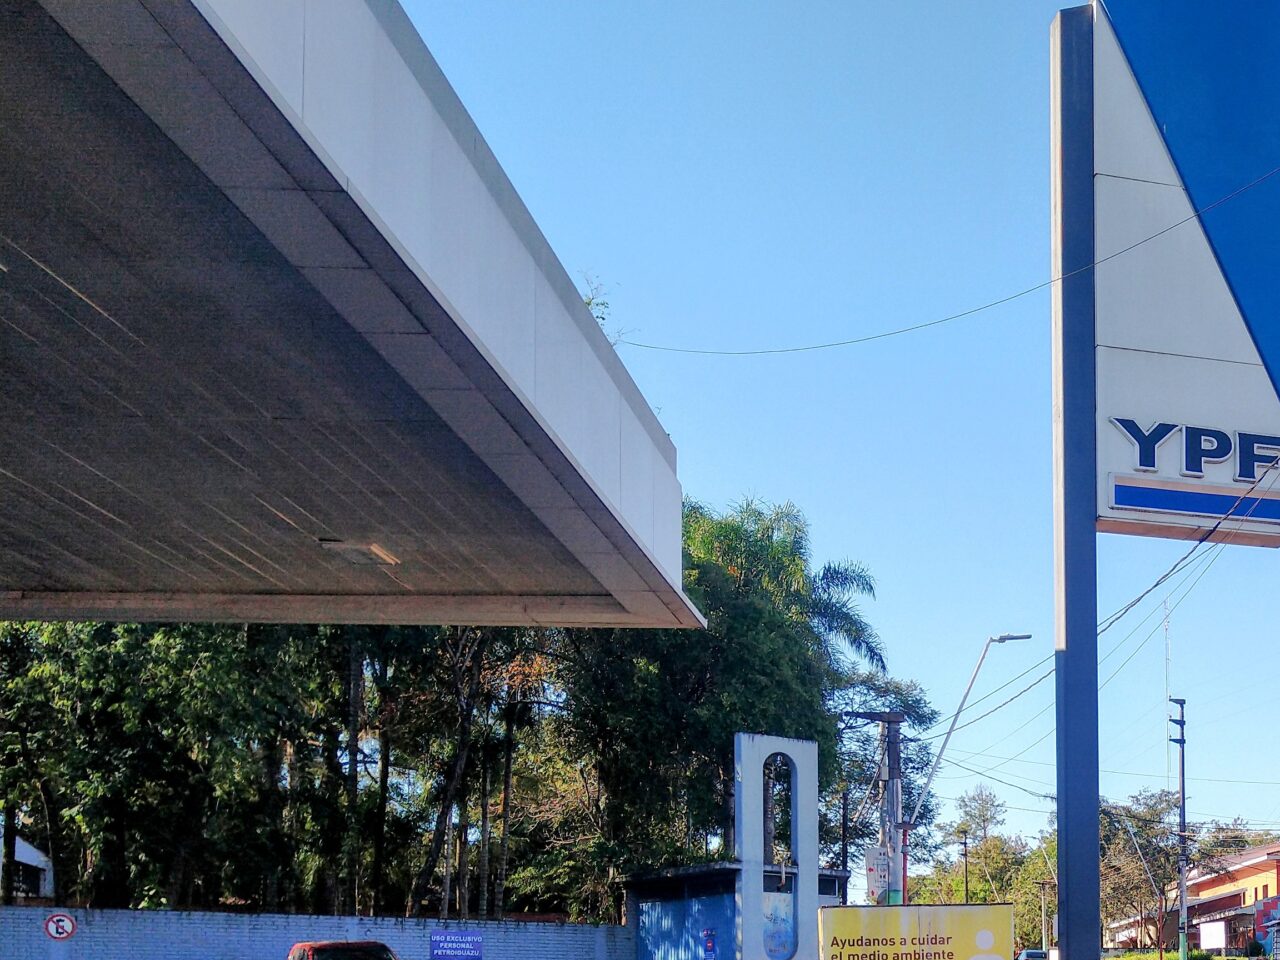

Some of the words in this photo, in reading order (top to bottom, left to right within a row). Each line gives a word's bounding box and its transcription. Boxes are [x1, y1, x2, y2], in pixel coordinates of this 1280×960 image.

[831, 936, 895, 949] Ayudanos
[911, 934, 953, 946] cuidar
[892, 949, 954, 960] ambiente
